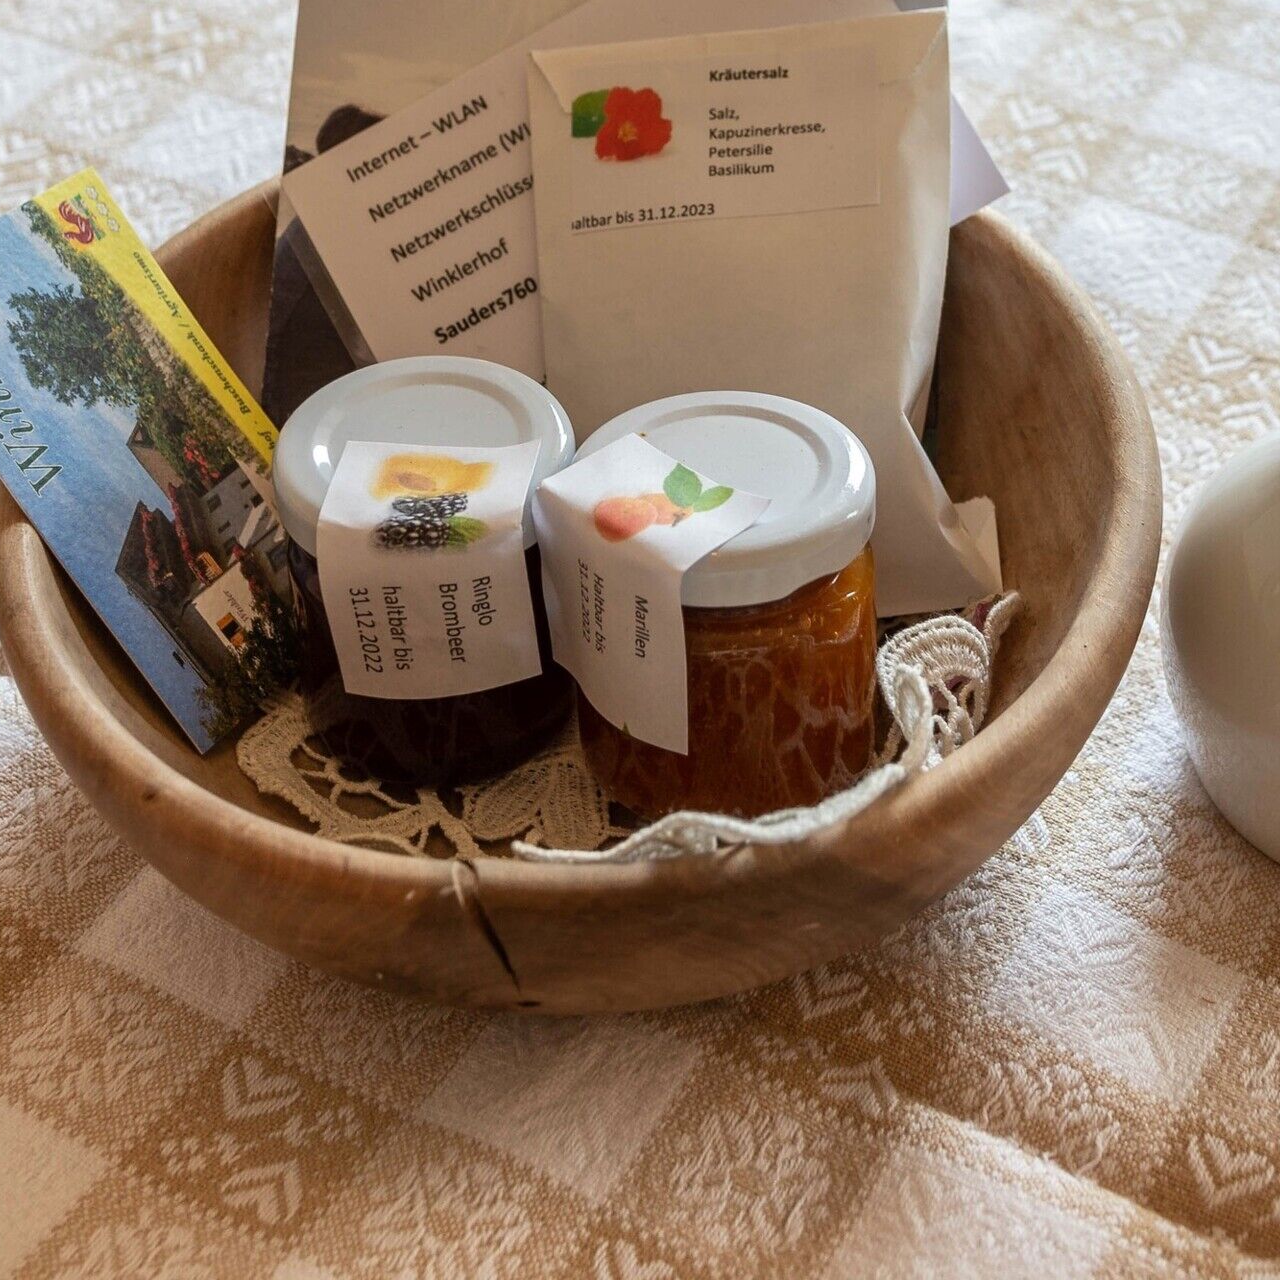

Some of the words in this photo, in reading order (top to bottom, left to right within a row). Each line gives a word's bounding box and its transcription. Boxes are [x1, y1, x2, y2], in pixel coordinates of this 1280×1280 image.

[709, 67, 789, 82] Kräutersalz
[346, 135, 418, 183] Internet
[431, 95, 489, 134] WLAN
[708, 107, 740, 121] Salz,
[708, 121, 826, 142] Kapuzinerkresse,
[708, 143, 773, 158] Petersilie
[708, 163, 775, 177] Basilikum
[368, 143, 498, 223] Netzwerkname
[616, 207, 634, 224] bis
[638, 203, 716, 222] 31.12.2023
[410, 237, 510, 303] Winklerhof
[434, 276, 538, 344] Sauders760
[186, 331, 251, 415] Buschenschank
[382, 586, 408, 644] haltbar
[439, 583, 466, 663] Brombeer
[472, 576, 497, 626] Ringlo
[634, 595, 650, 659] Marillen
[349, 587, 384, 673] 31.12.2022
[595, 631, 607, 653] bis
[393, 648, 415, 670] bis
